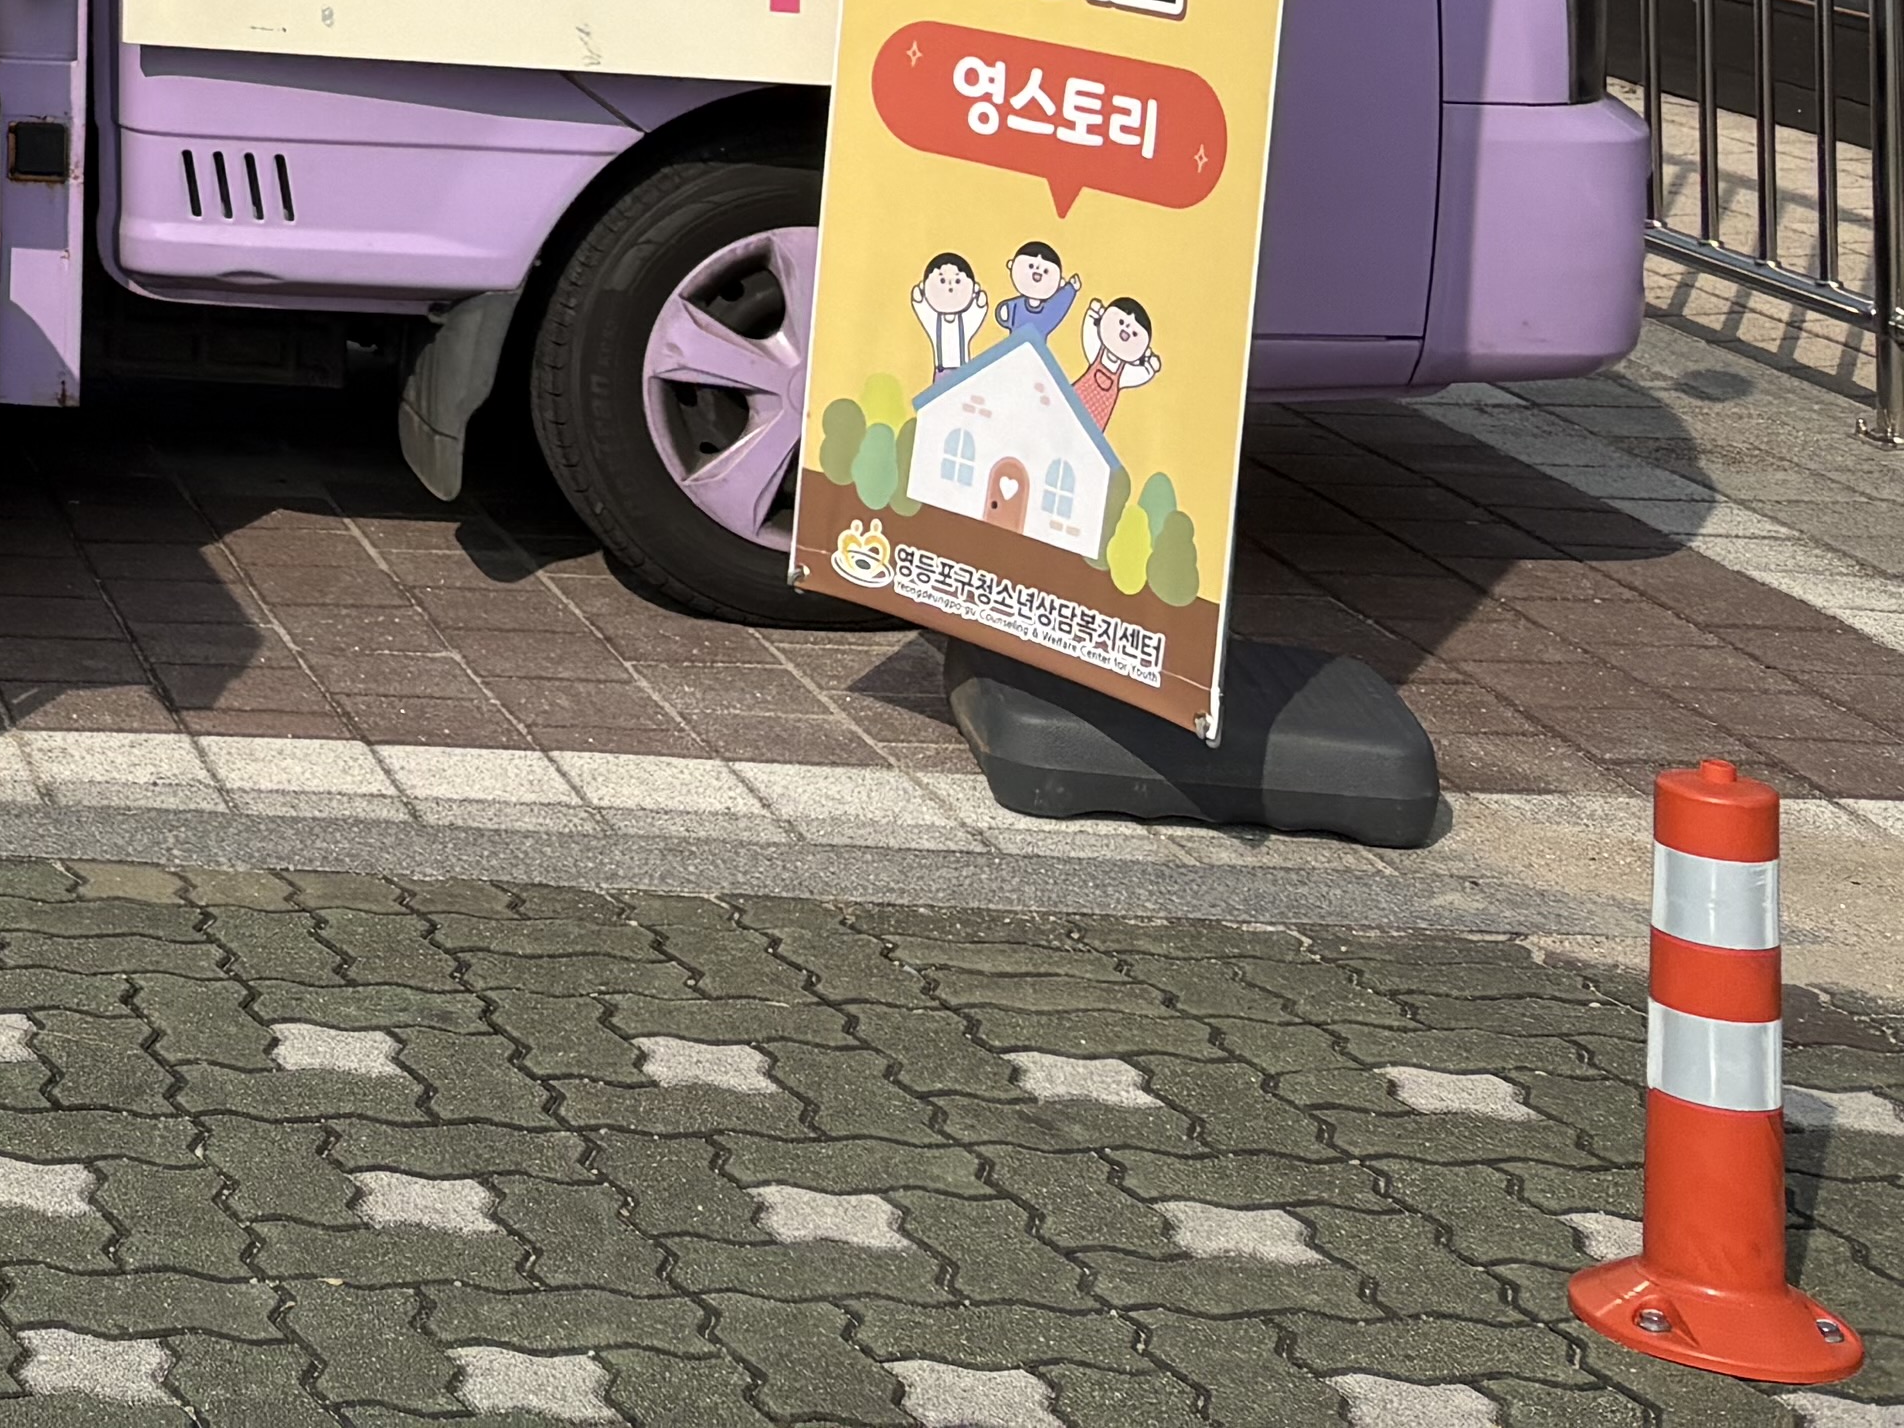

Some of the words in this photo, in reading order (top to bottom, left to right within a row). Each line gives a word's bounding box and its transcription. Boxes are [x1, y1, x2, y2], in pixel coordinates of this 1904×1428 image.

[951, 54, 1161, 160] 영스토리
[896, 547, 1163, 669] 영등포구청소년상담복지센터
[979, 609, 1030, 637] Counseling
[1042, 630, 1078, 654] Welfare
[1079, 644, 1112, 666] Center
[1113, 656, 1128, 672] for
[1130, 664, 1159, 684] Youth
